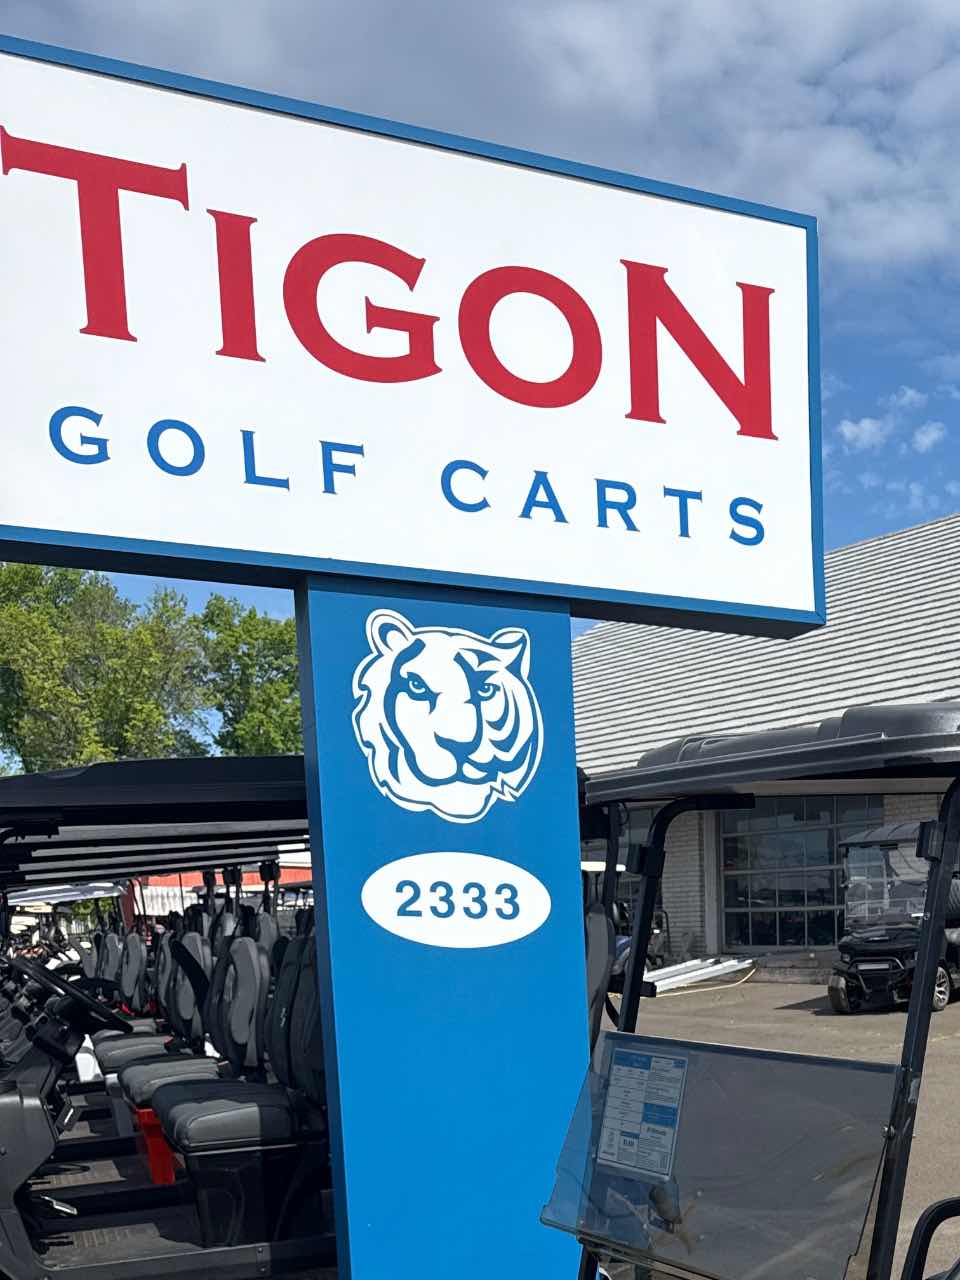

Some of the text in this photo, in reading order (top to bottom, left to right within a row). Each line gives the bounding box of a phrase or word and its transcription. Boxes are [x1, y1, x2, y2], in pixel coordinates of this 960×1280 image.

[0, 125, 778, 441] TIGON
[48, 404, 766, 547] GOLF CARTS
[395, 879, 520, 921] 2333
